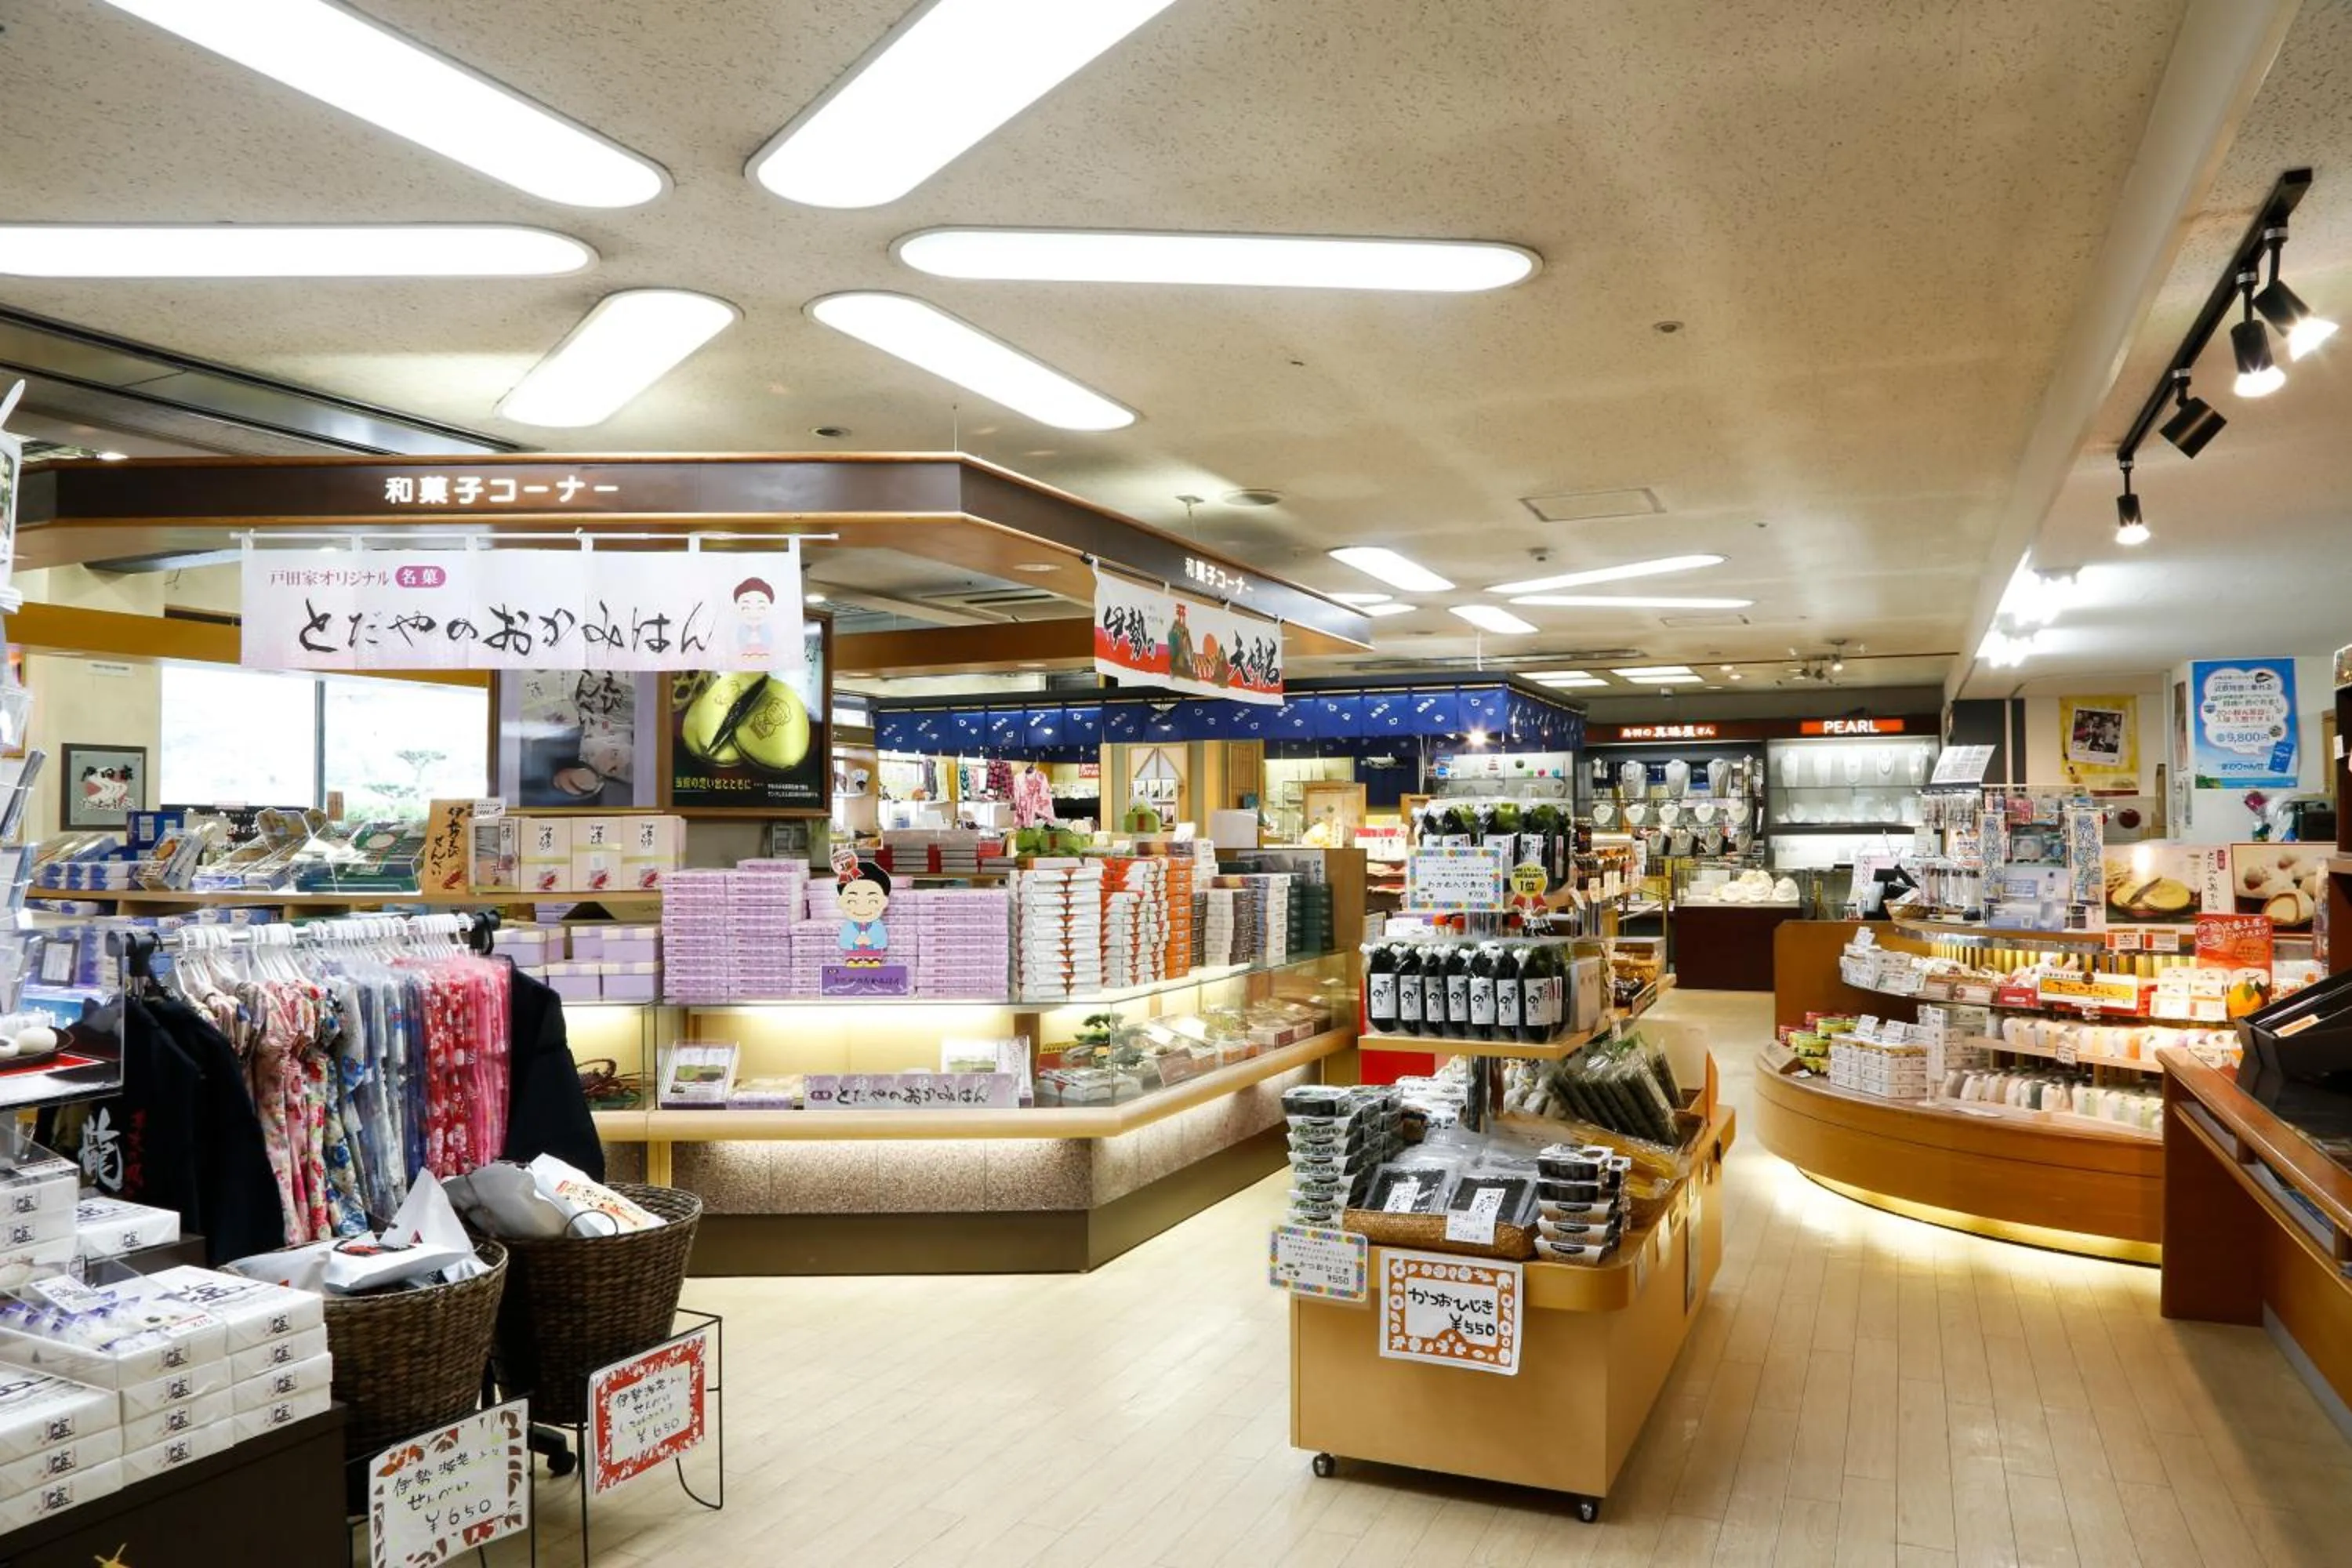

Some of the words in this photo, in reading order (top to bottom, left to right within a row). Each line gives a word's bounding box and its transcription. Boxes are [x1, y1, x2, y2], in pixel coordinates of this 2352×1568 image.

[384, 476, 619, 504] 和菓子コーナー
[270, 569, 390, 587] 戸田家オリジナル
[1184, 557, 1254, 594] 和菓子コーナー
[298, 598, 716, 653] とだやのおかみはん
[1823, 719, 1880, 733] PEARL
[1408, 1287, 1494, 1315] かつおひじき
[1450, 1313, 1496, 1337] ¥550
[637, 1417, 681, 1444] ¥650
[425, 1498, 492, 1533] ¥650
